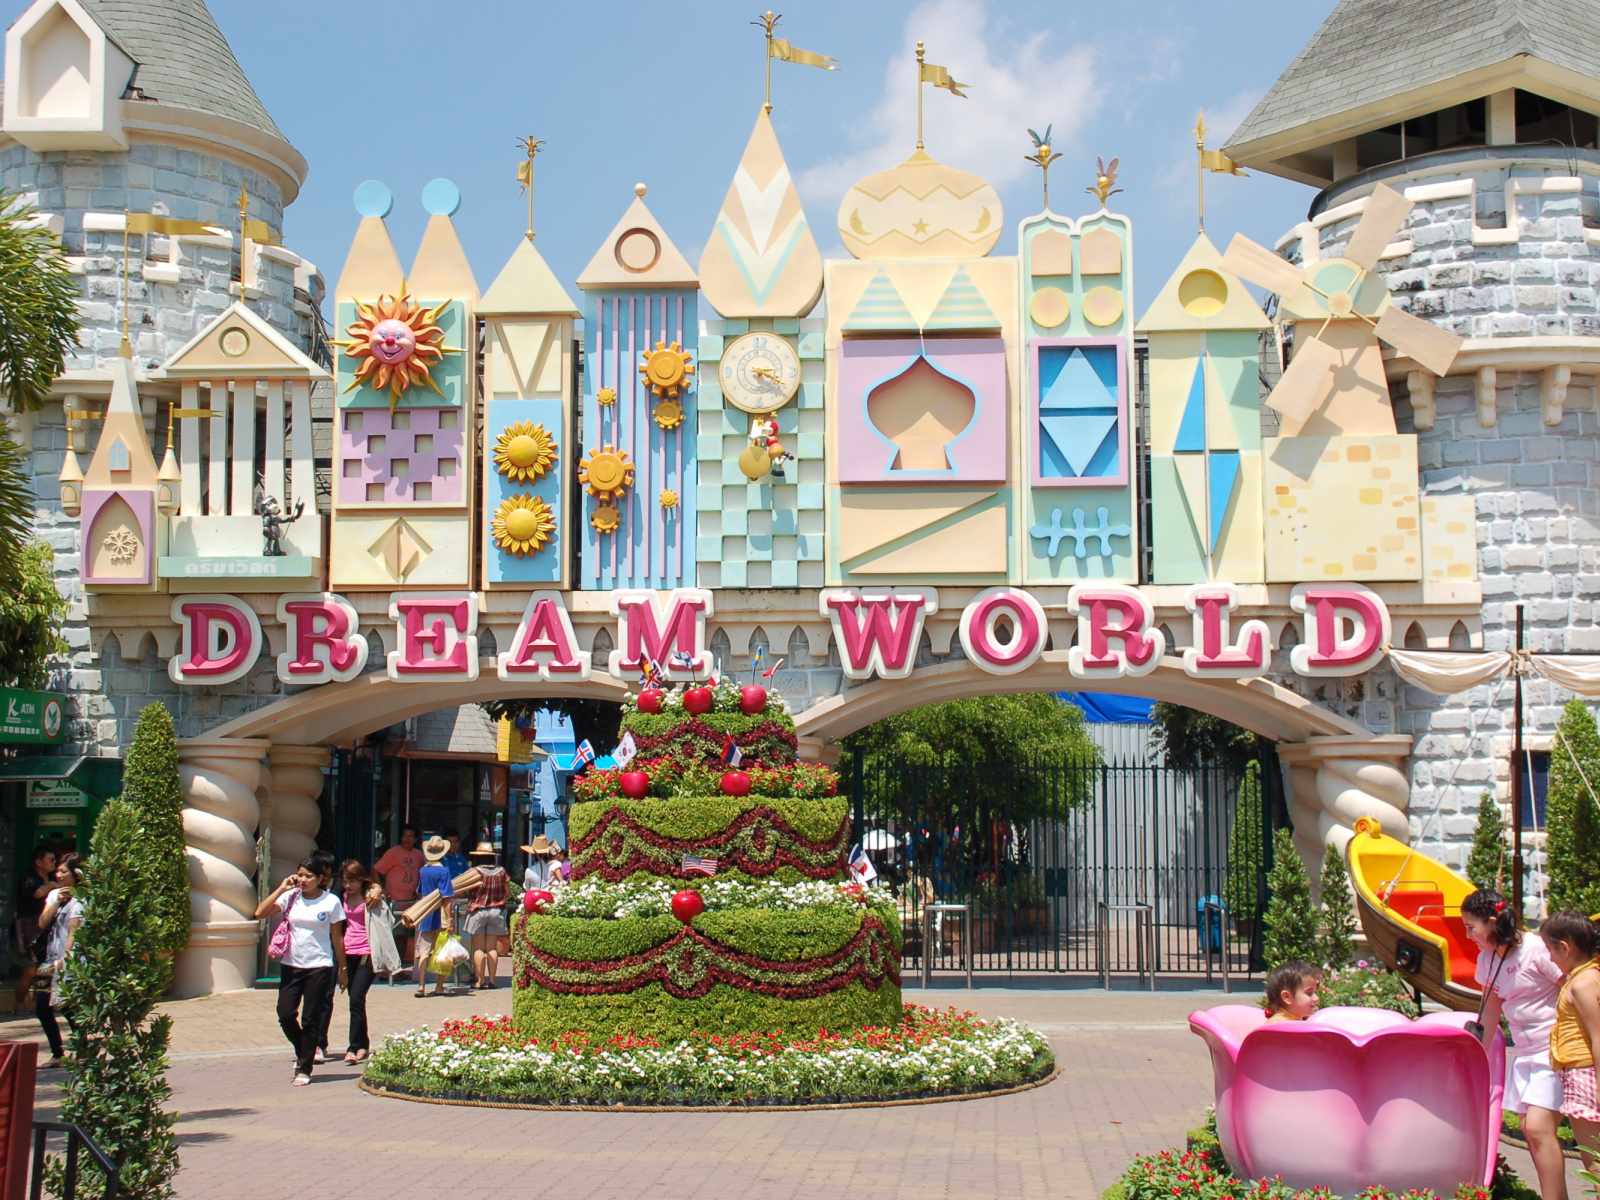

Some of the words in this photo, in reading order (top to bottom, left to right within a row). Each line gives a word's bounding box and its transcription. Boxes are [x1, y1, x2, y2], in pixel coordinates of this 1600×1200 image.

[753, 337, 767, 348] 12
[168, 588, 714, 685] DREAM
[819, 583, 1392, 679] WORLD
[8, 697, 19, 717] K
[20, 703, 35, 715] ATM
